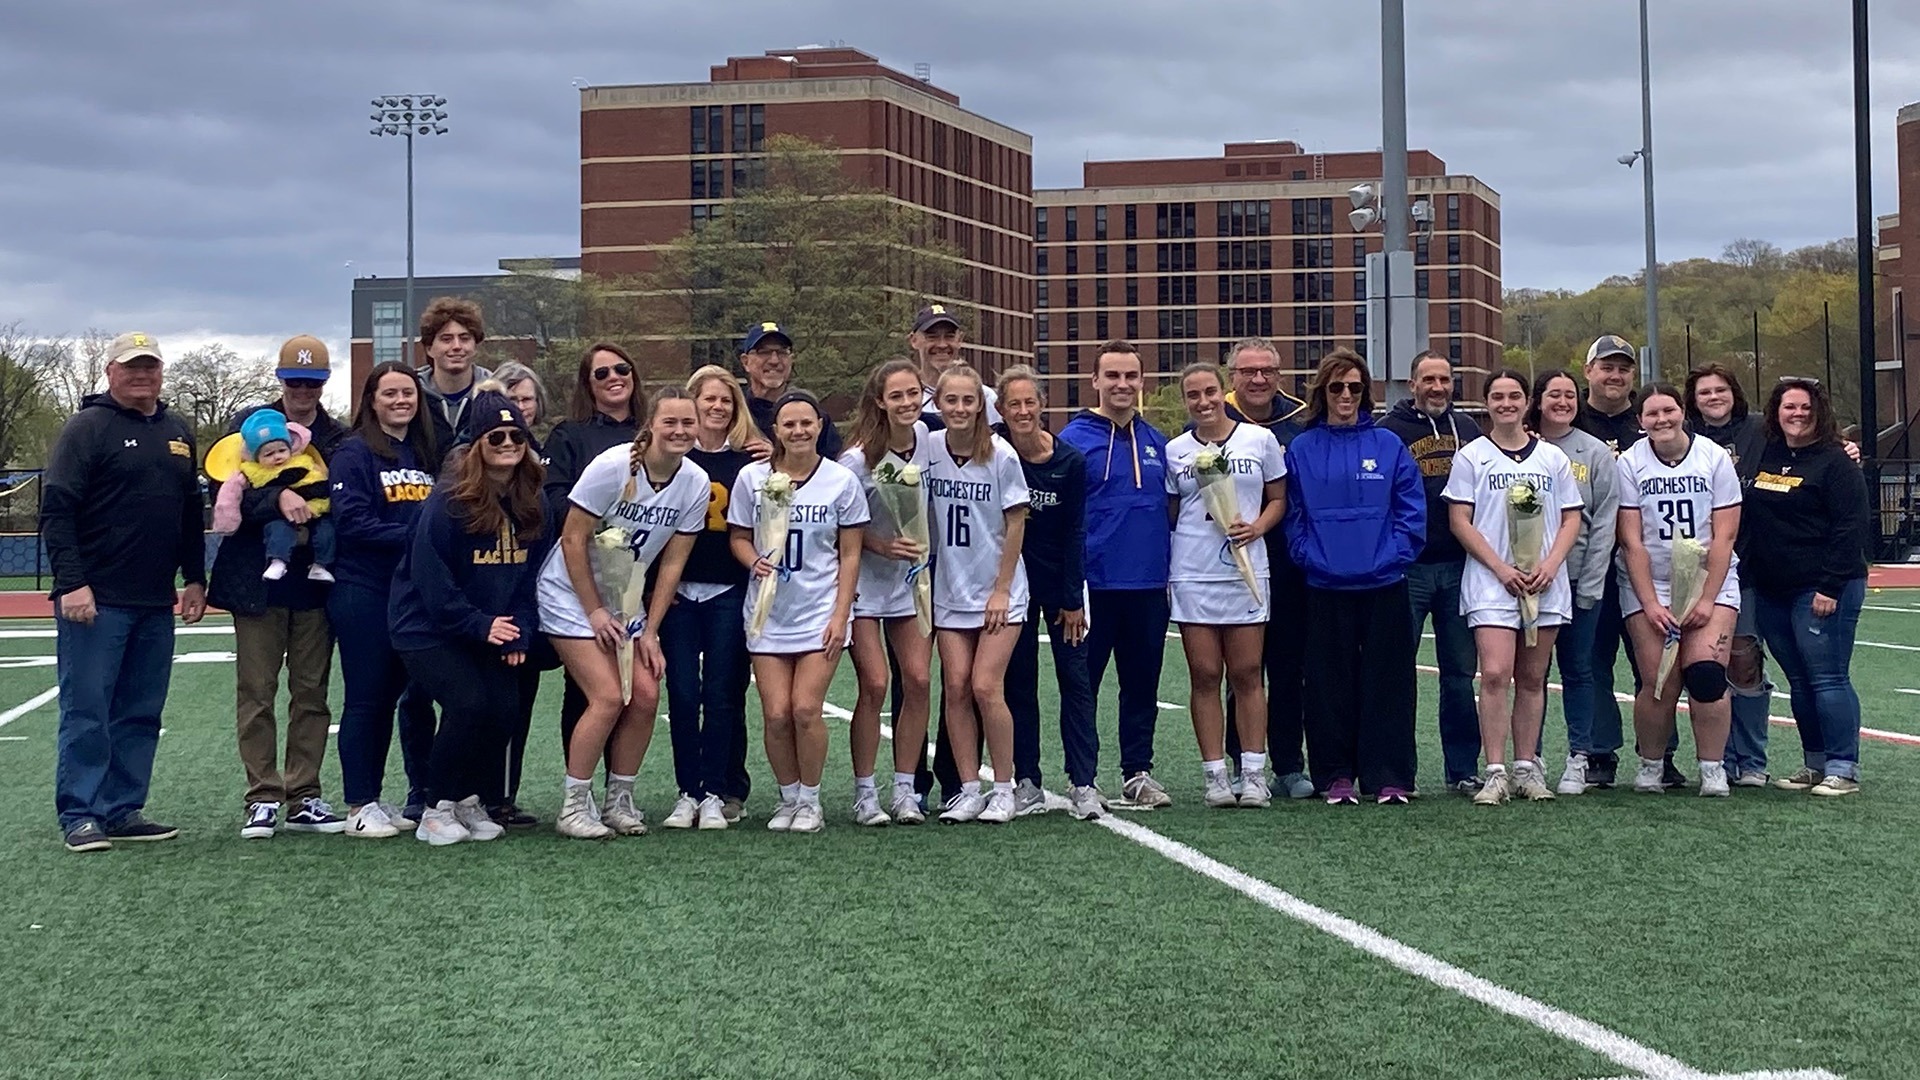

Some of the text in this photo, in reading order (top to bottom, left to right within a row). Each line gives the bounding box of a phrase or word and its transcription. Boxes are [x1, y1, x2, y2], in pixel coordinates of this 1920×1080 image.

[297, 349, 313, 365] NY
[615, 500, 680, 527] ROCHESTER
[947, 503, 971, 548] 16
[1657, 499, 1696, 540] 39
